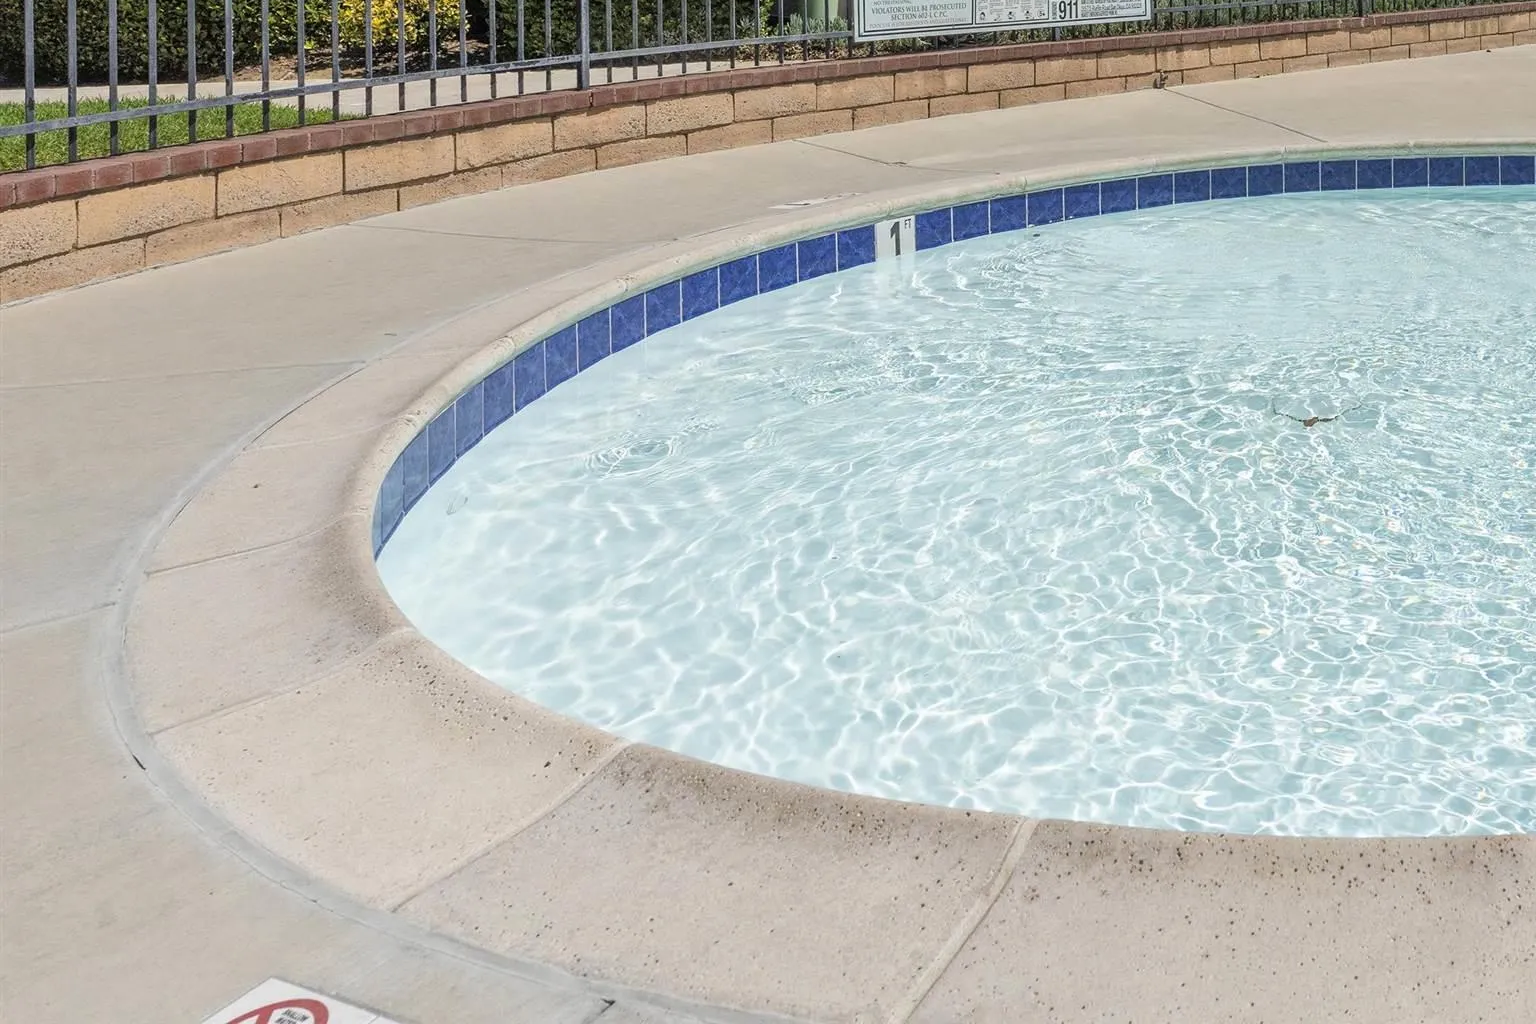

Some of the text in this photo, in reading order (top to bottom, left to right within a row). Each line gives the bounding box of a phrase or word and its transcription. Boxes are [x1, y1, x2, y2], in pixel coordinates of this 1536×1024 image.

[929, 3, 966, 11] PROSECUTED
[1059, 1, 1078, 19] 911
[889, 221, 901, 256] 1
